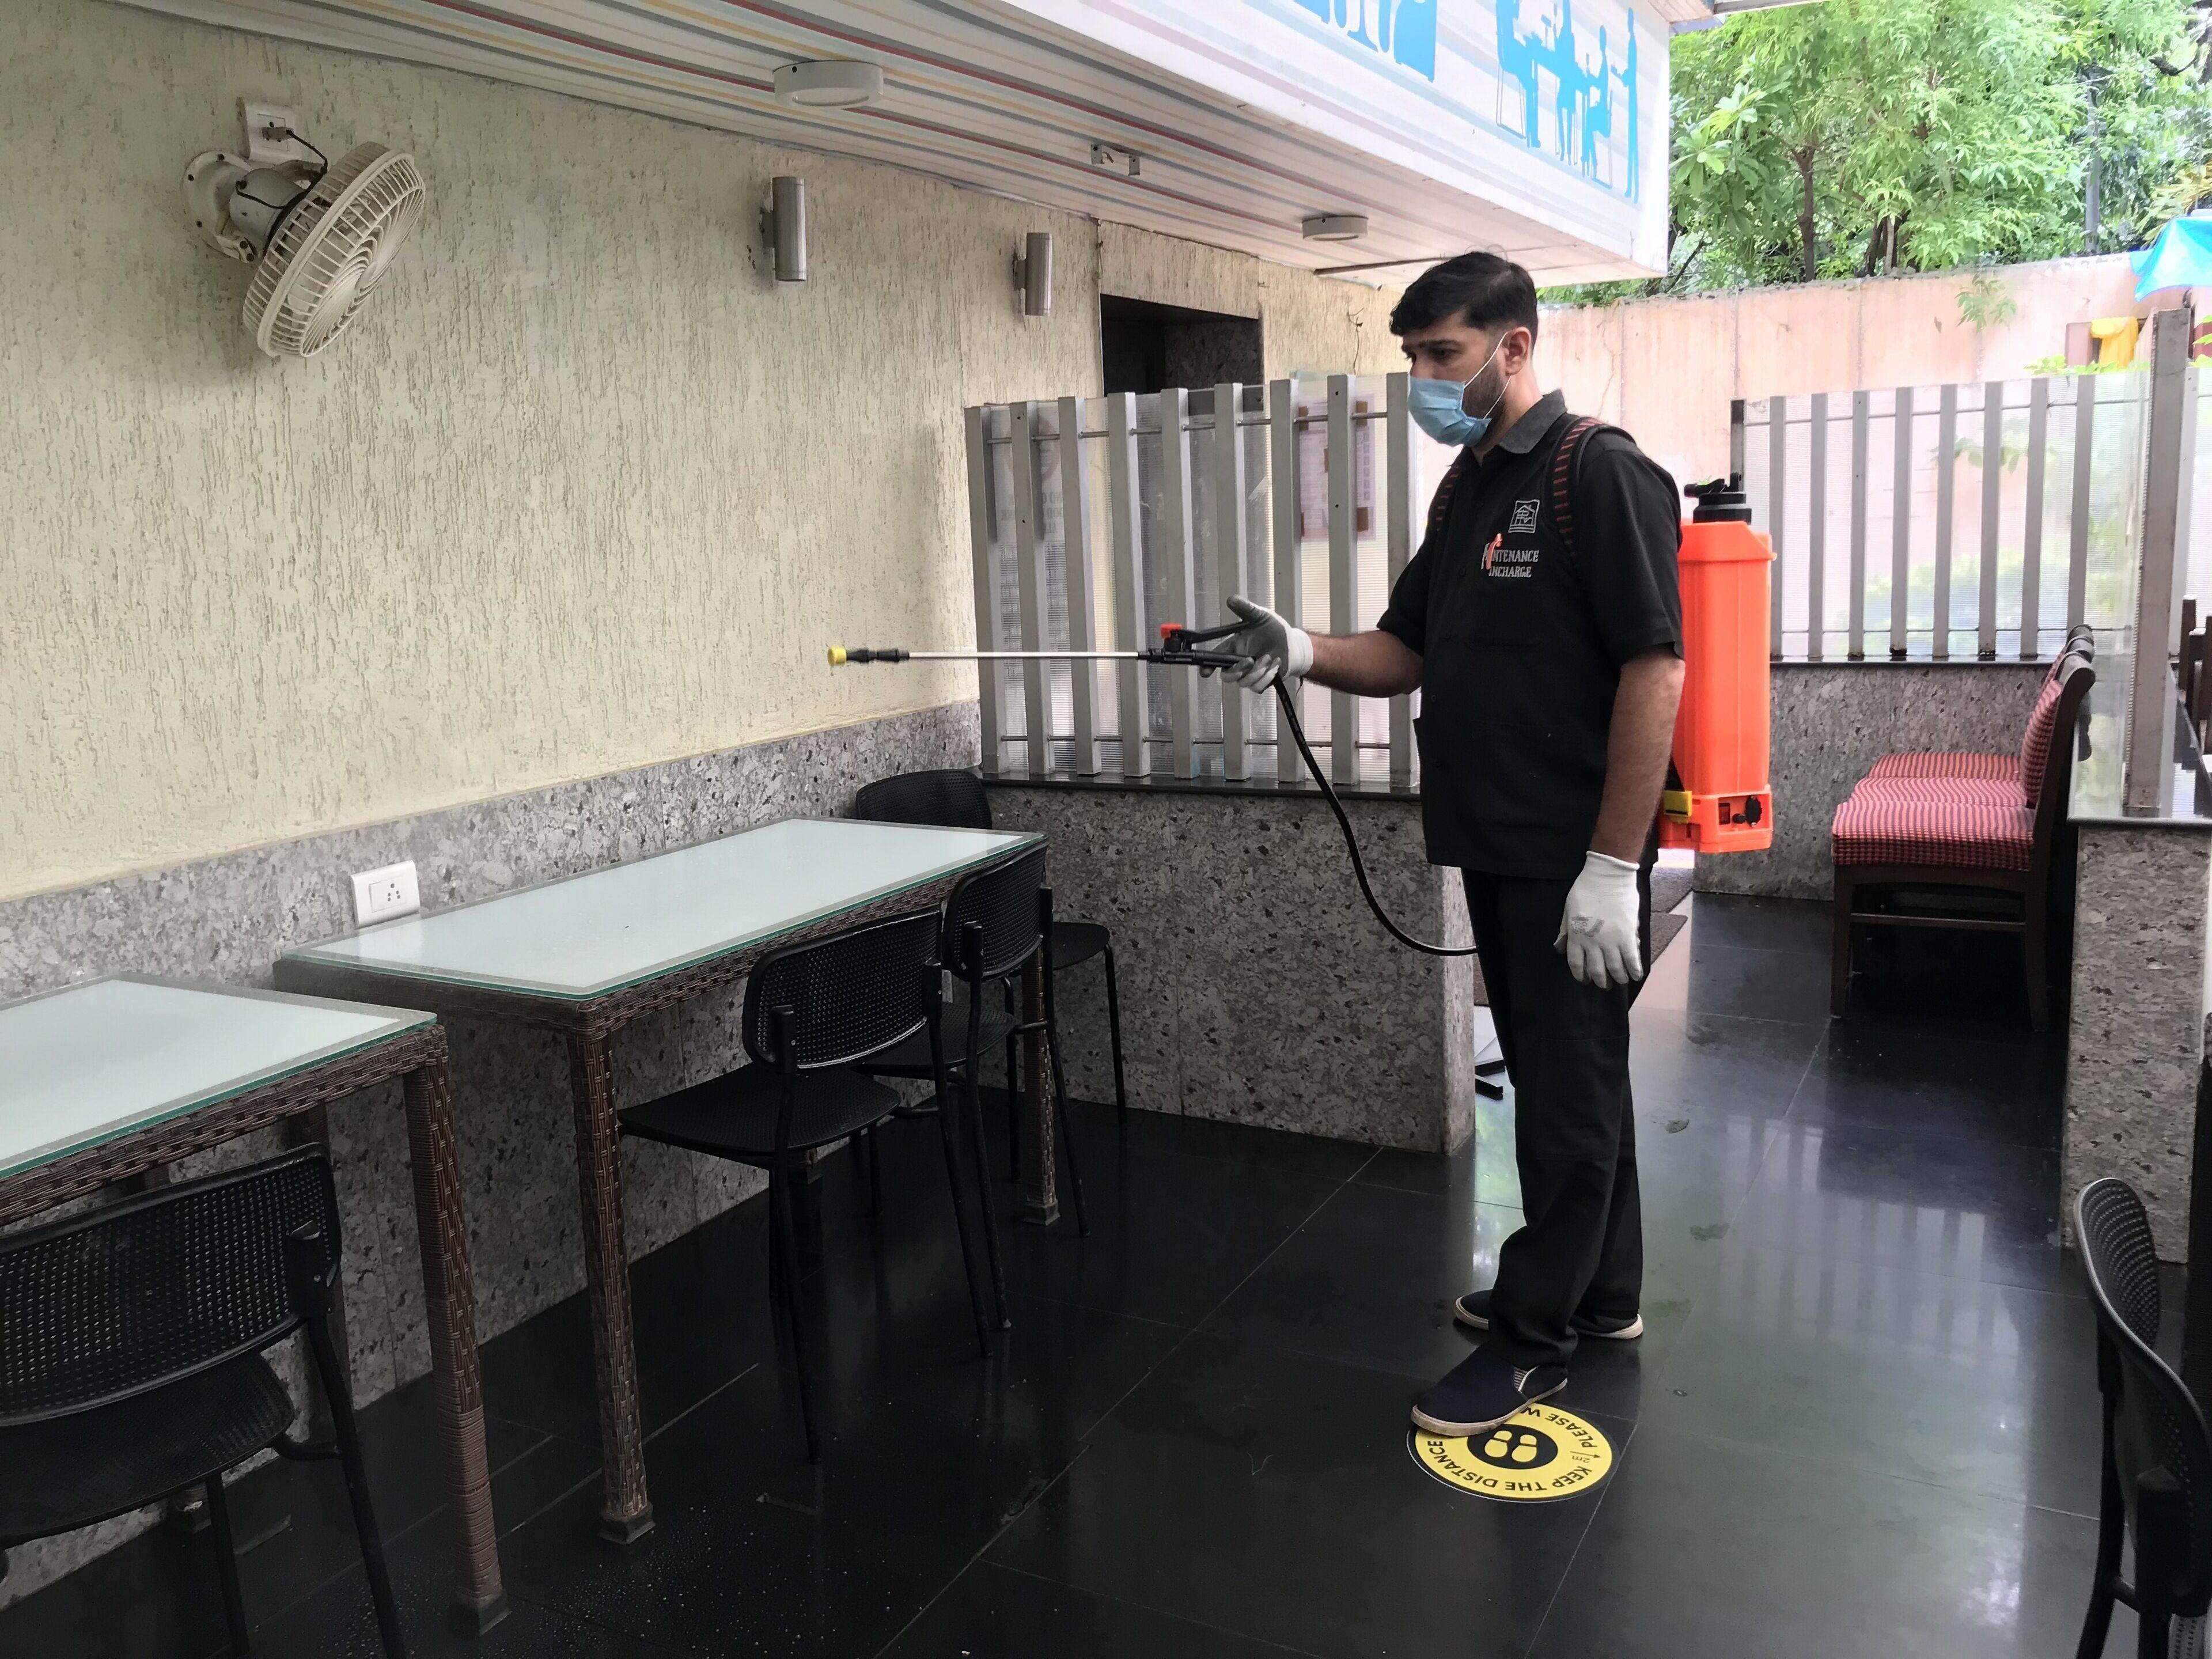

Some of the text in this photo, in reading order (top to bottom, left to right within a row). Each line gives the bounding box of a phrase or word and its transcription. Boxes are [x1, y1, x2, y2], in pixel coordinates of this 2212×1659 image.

[1488, 566, 1532, 577] INCHARGE
[1545, 1414, 1598, 1448] PLEASE
[1427, 1441, 1592, 1491] KEEP THE DISTANCE
